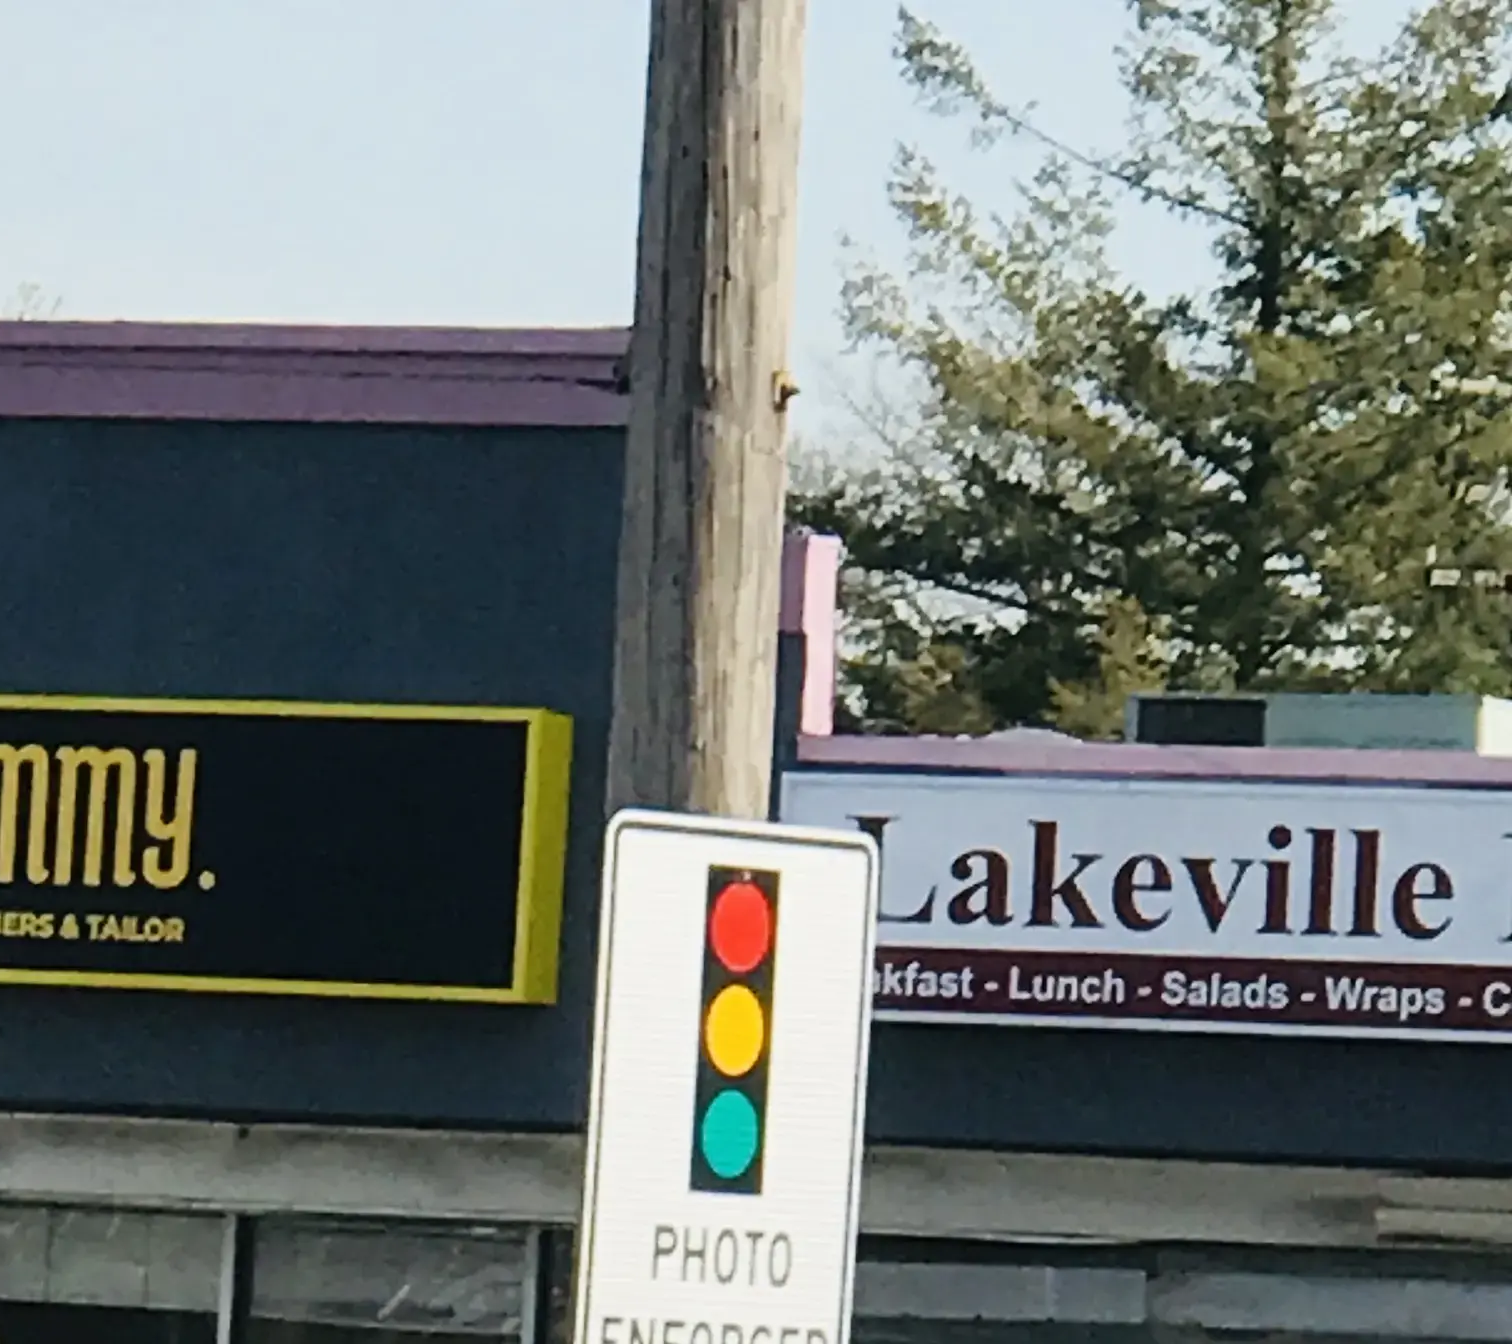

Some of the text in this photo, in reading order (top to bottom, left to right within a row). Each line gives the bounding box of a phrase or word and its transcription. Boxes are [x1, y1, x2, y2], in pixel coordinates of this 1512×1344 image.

[845, 814, 1454, 941] Lakeville
[59, 912, 80, 940] &
[84, 913, 186, 942] TAILOR
[1008, 965, 1125, 1004] Lunch
[1160, 970, 1290, 1010] Salads
[1324, 975, 1446, 1022] Wraps
[651, 1224, 793, 1288] PHOTO
